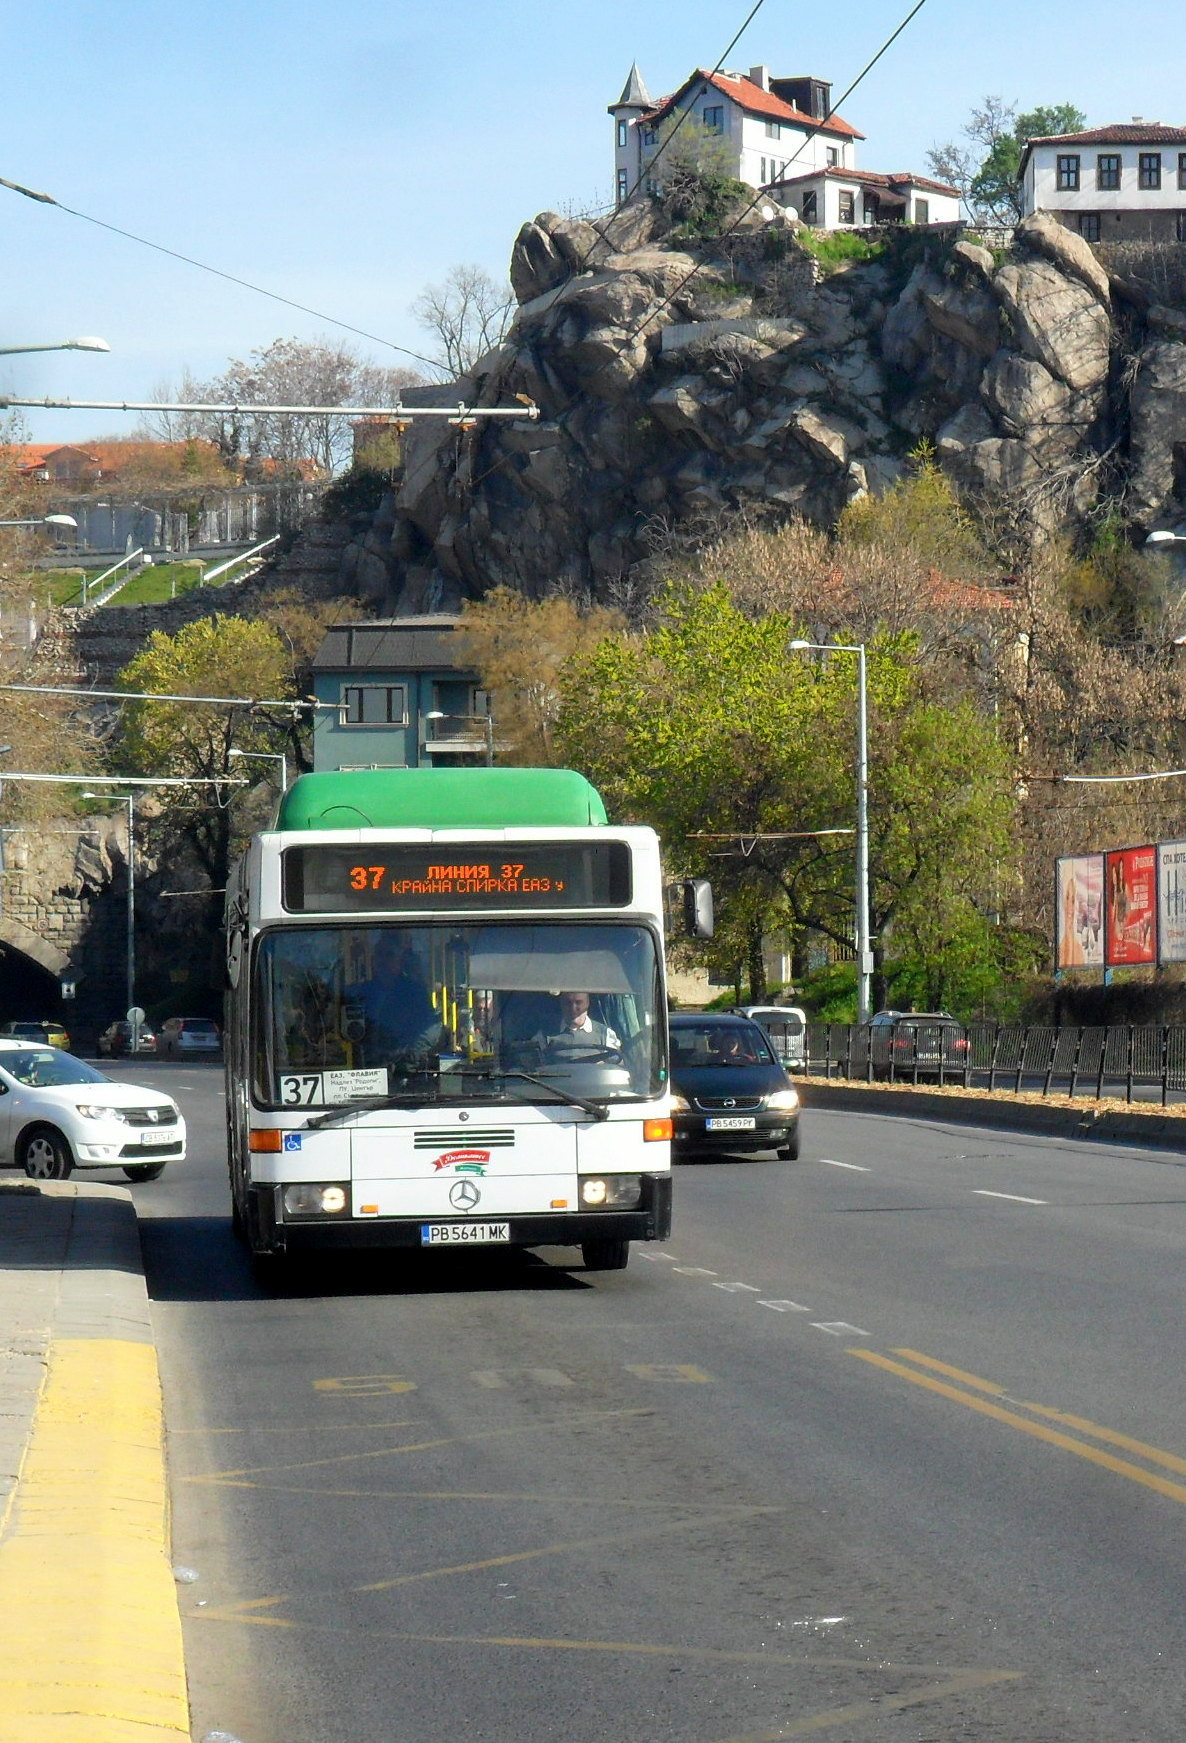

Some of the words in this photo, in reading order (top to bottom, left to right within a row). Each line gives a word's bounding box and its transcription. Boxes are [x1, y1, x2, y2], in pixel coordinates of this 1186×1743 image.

[350, 865, 386, 890] 37
[427, 865, 490, 880] ЛИНИЯ
[501, 864, 525, 878] 37
[456, 878, 518, 894] СПИРКА
[284, 1076, 320, 1105] 37
[711, 1119, 722, 1128] PB
[723, 1119, 742, 1127] 5459
[431, 1226, 450, 1241] PB
[452, 1225, 485, 1241] 5641
[488, 1224, 507, 1240] MK
